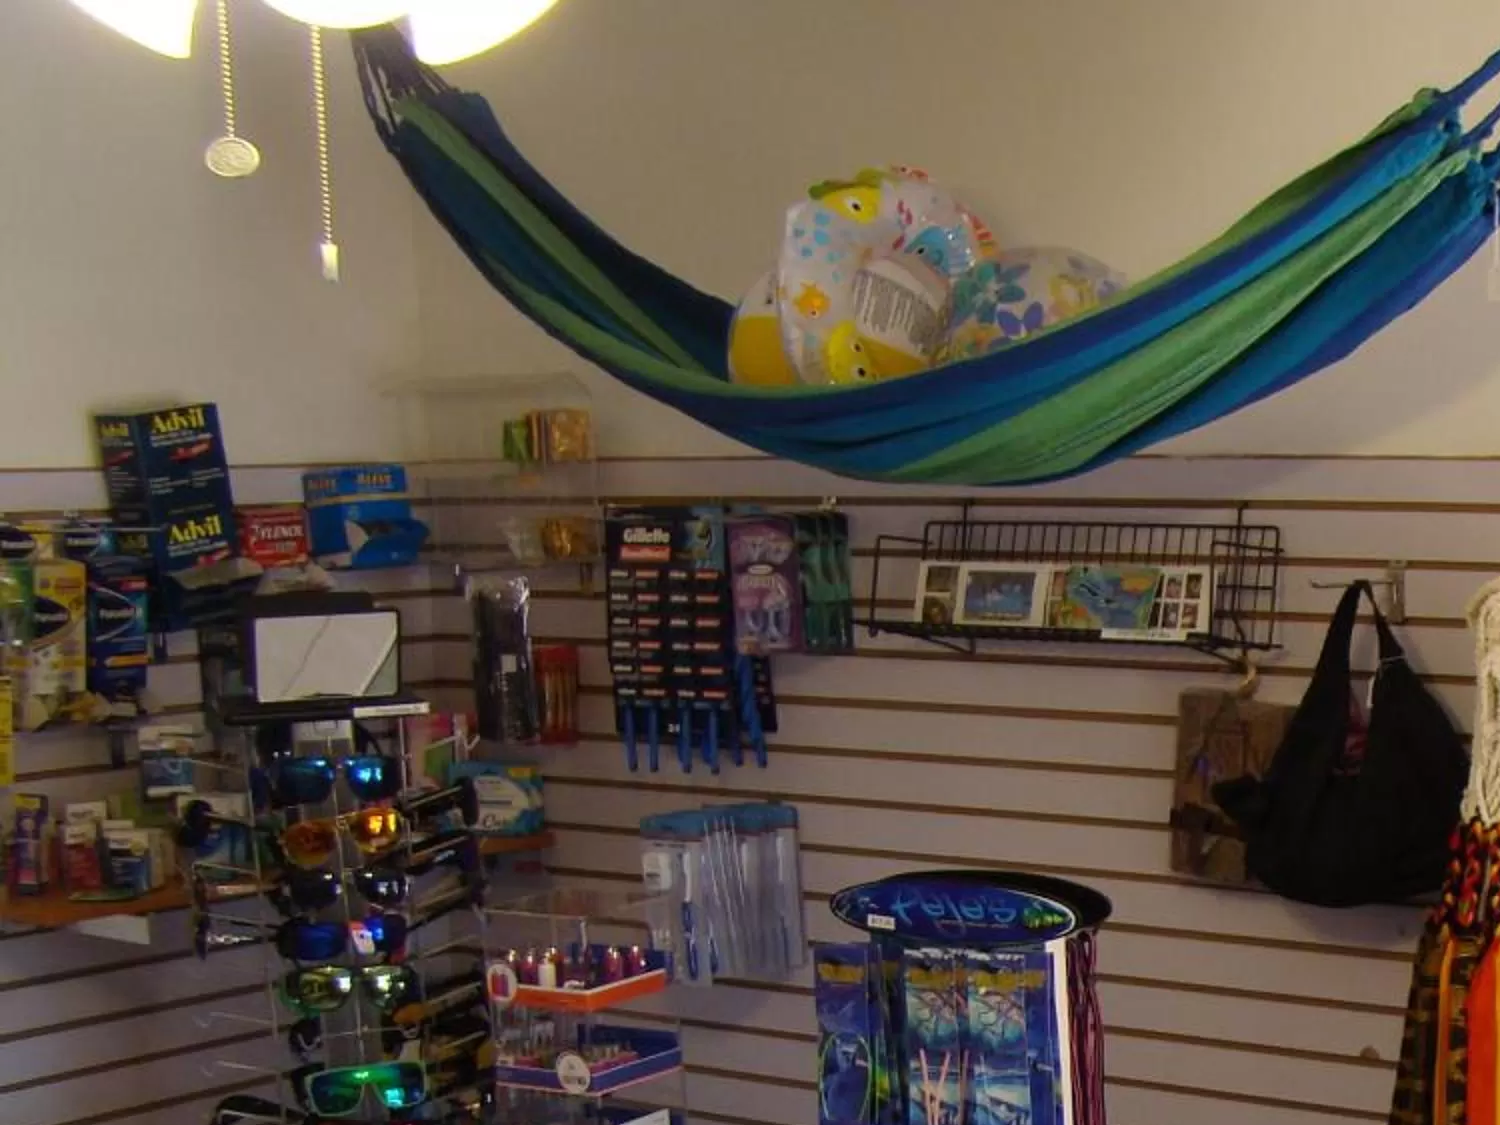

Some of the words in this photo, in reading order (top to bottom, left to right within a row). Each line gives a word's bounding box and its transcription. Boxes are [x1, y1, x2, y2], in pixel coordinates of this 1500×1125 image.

[152, 408, 206, 433] Advil
[169, 514, 222, 545] Advil
[251, 524, 305, 544] TYLENOL
[624, 527, 671, 545] Gillette
